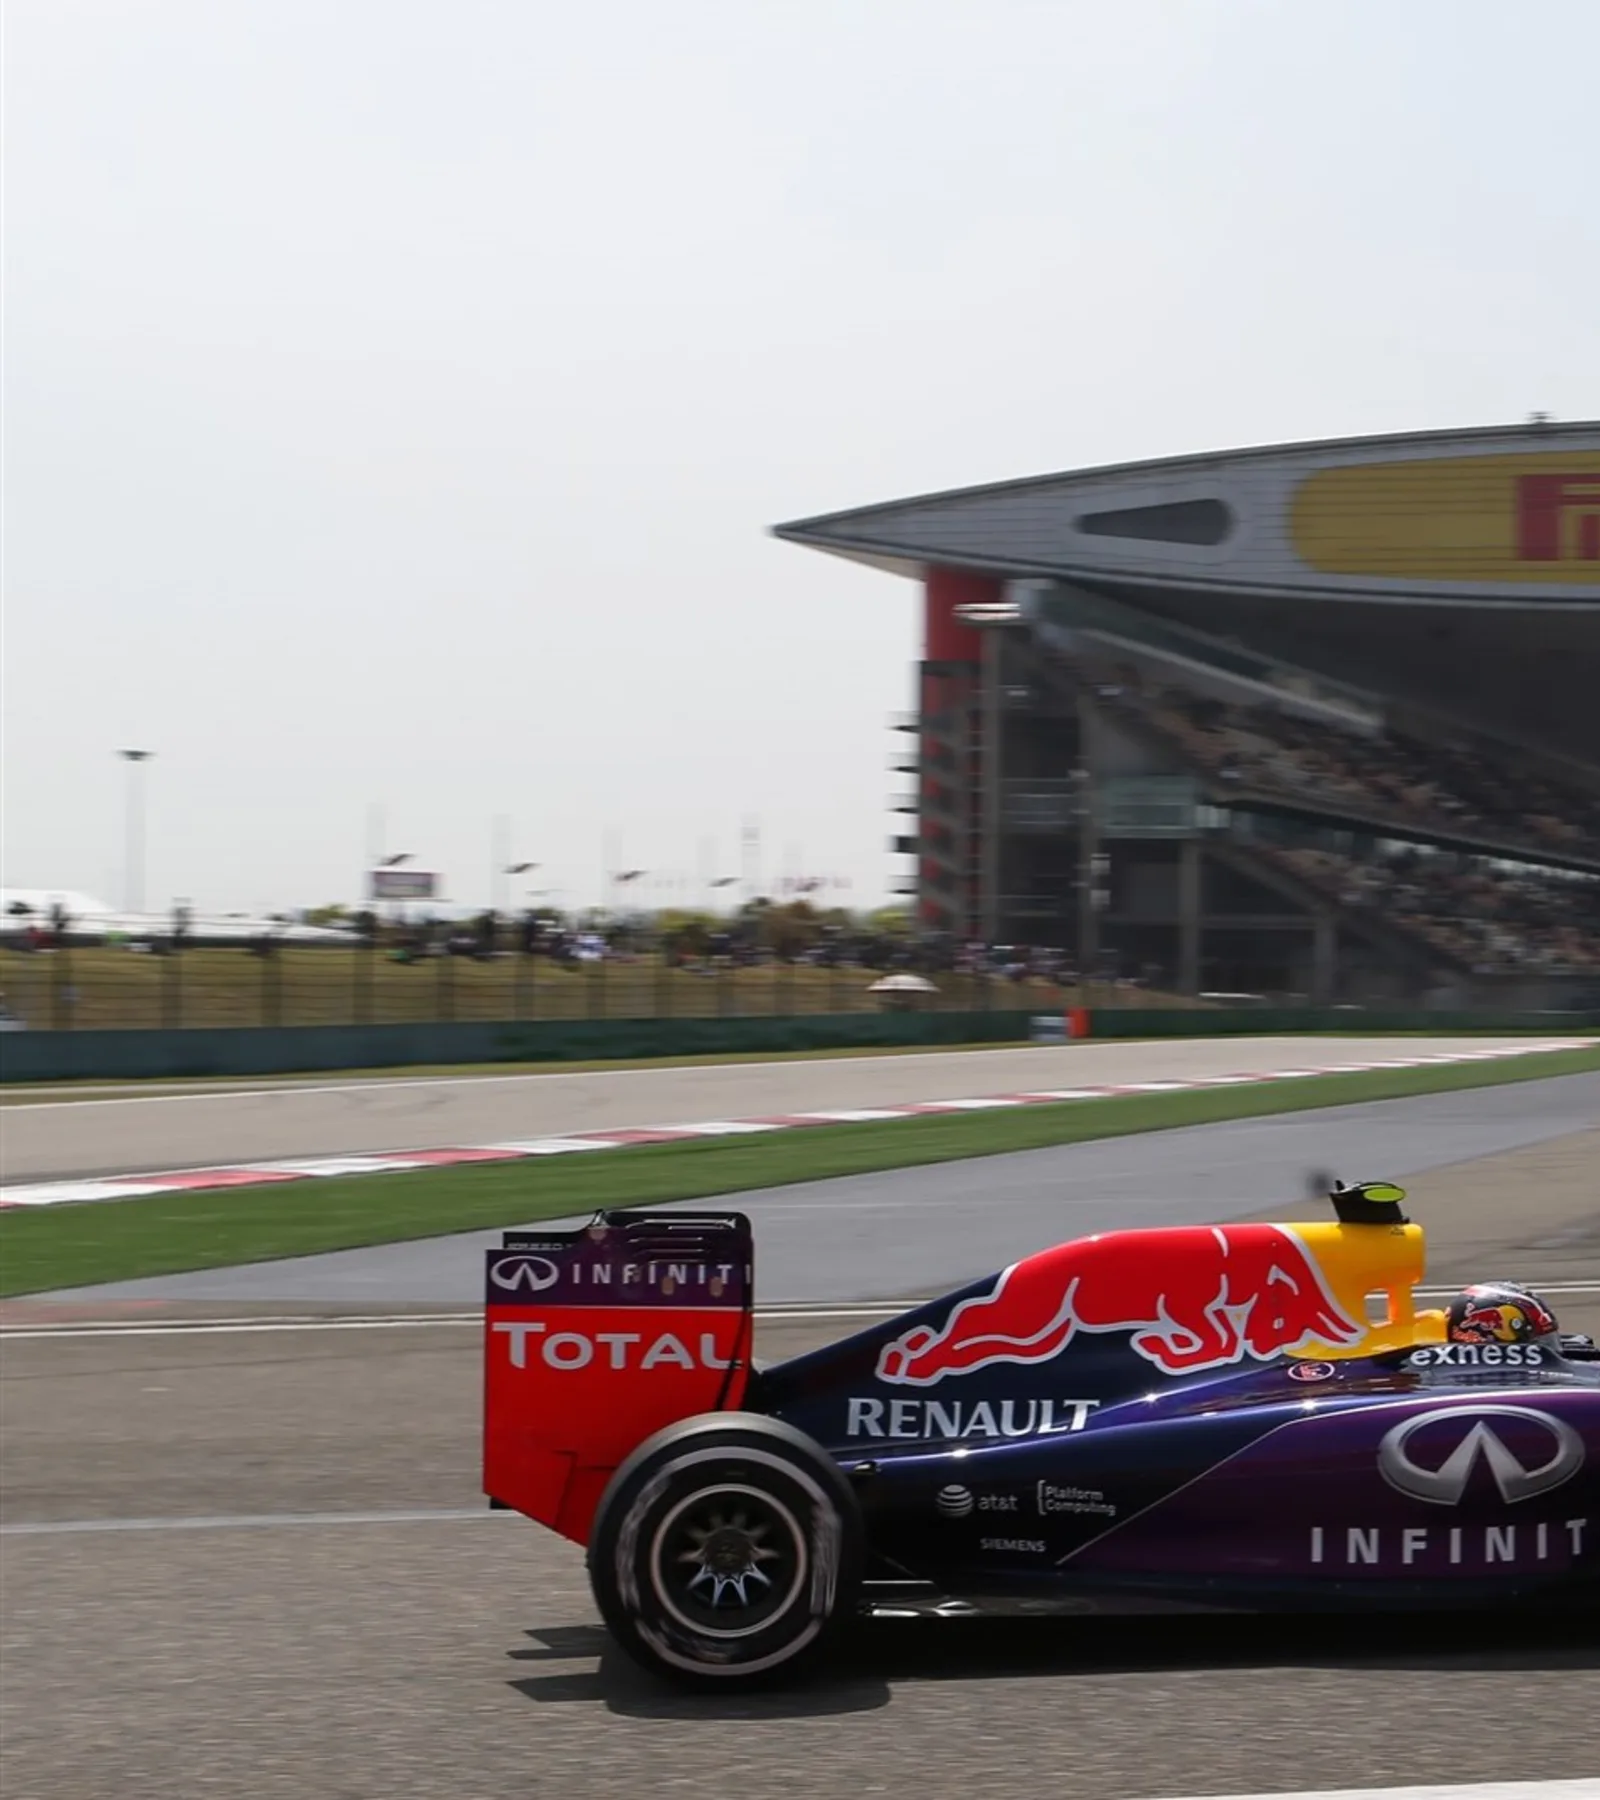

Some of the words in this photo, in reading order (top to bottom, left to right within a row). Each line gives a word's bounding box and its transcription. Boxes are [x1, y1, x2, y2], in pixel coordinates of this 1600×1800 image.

[572, 1263, 751, 1285] INFINITI
[1410, 1344, 1543, 1366] exness
[846, 1397, 1099, 1438] RENAULT
[1045, 1486, 1104, 1501] Platform
[1045, 1499, 1117, 1517] Computing
[980, 1538, 1047, 1552] SIEMENS
